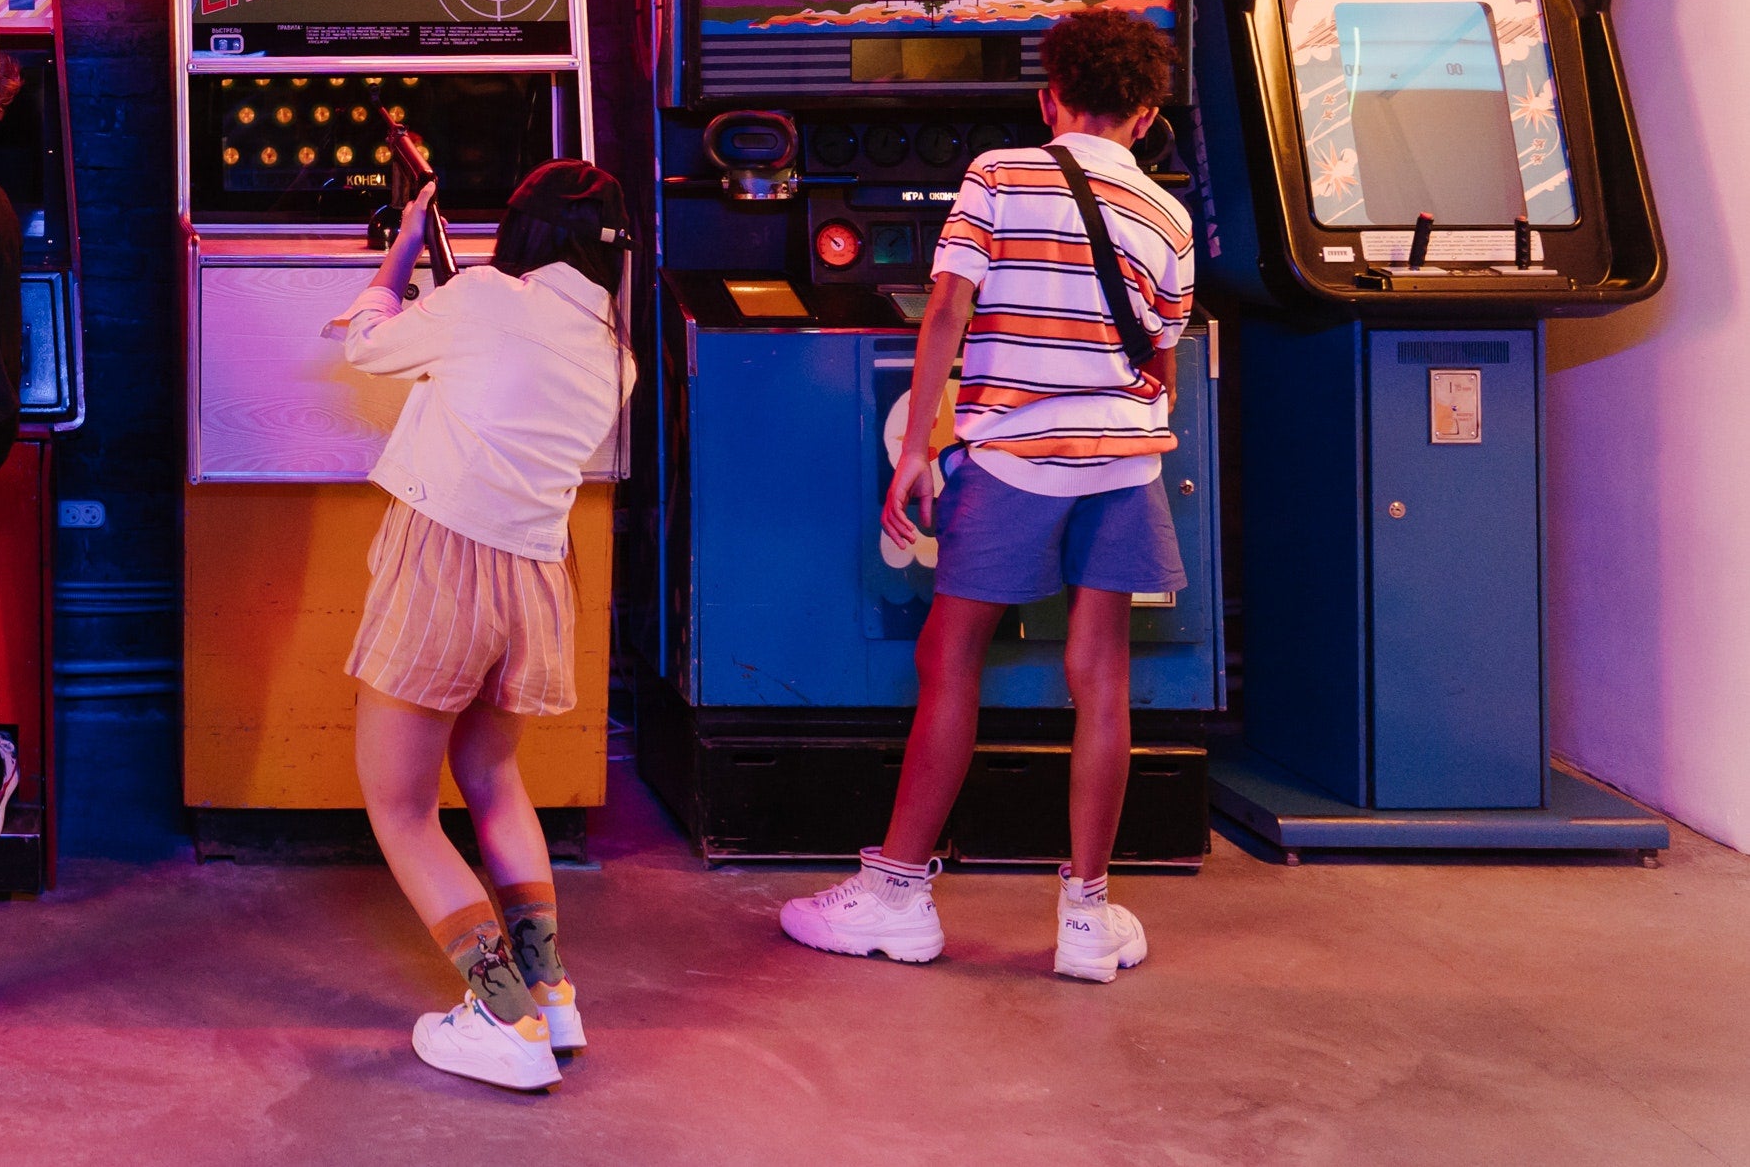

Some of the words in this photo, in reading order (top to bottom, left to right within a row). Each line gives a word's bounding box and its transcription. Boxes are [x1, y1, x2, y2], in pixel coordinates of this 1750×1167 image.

[347, 174, 386, 186] КОНЕЦ
[902, 191, 924, 201] ИГРА
[886, 876, 910, 888] FILA
[843, 900, 858, 910] FILA
[1066, 919, 1090, 931] FILA
